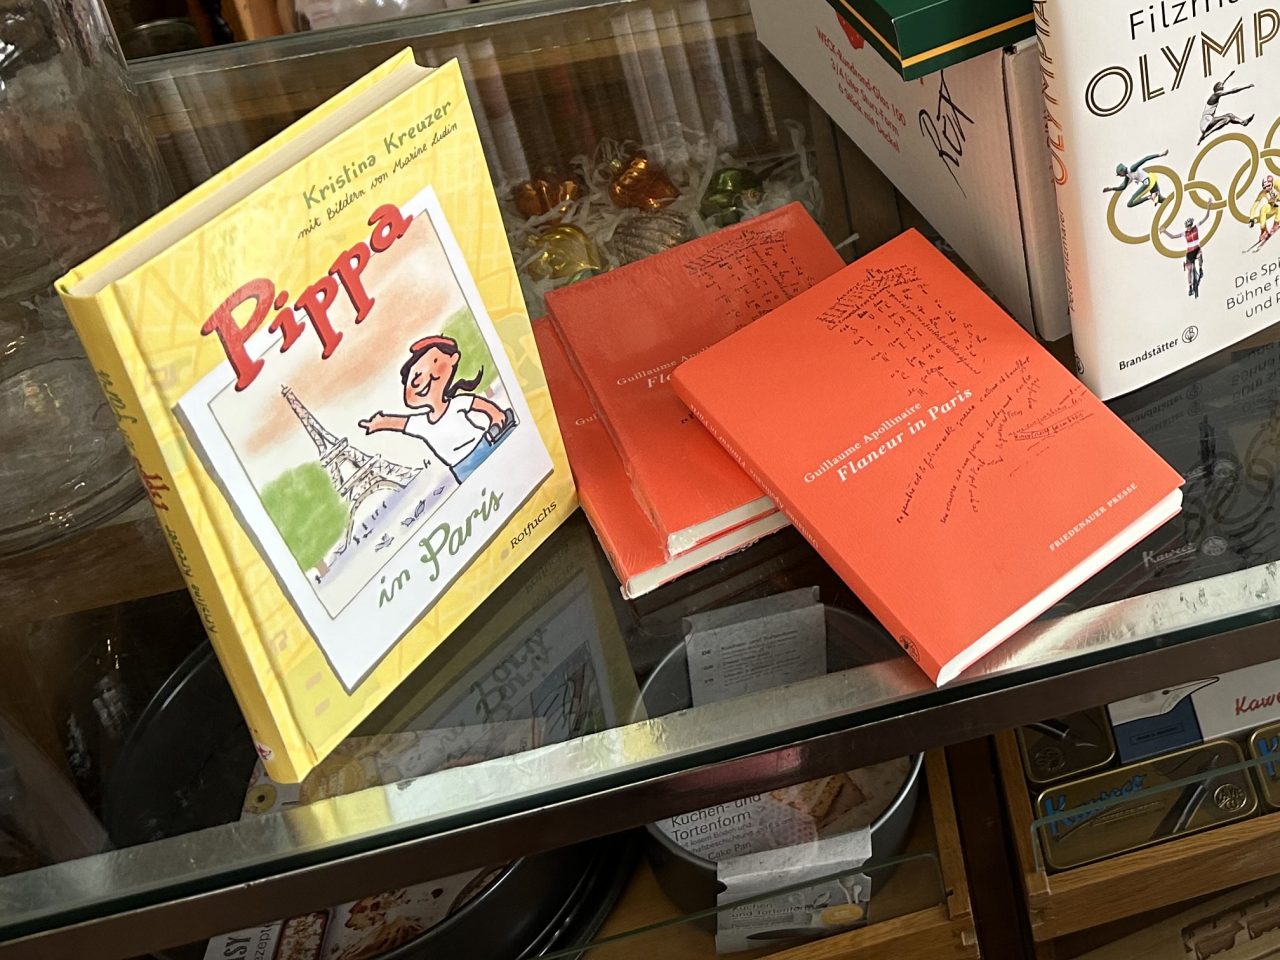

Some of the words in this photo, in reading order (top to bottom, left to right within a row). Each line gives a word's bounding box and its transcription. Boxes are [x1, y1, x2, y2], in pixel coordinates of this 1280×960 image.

[302, 152, 379, 211] Kristina
[383, 98, 454, 154] Kreuzer
[297, 216, 323, 241] mit
[326, 187, 368, 227] Bildern
[370, 170, 391, 192] von
[391, 143, 429, 176] Marine
[199, 201, 415, 394] Pippa
[1225, 281, 1272, 311] Bühne
[1234, 269, 1259, 290] Die
[1244, 299, 1274, 319] und
[1118, 338, 1180, 371] Brandstätter
[802, 442, 863, 486] Guillaume
[862, 401, 923, 446] Apollinaire
[836, 431, 907, 483] Flaneur
[908, 411, 929, 438] in
[928, 386, 974, 425] Paris
[377, 568, 411, 609] in
[418, 488, 505, 583] Paris
[508, 498, 558, 551] Rotfuchs
[1048, 506, 1108, 553] FRIEDENAUER
[1107, 480, 1139, 508] PRESSE
[672, 812, 751, 842] Tortenform
